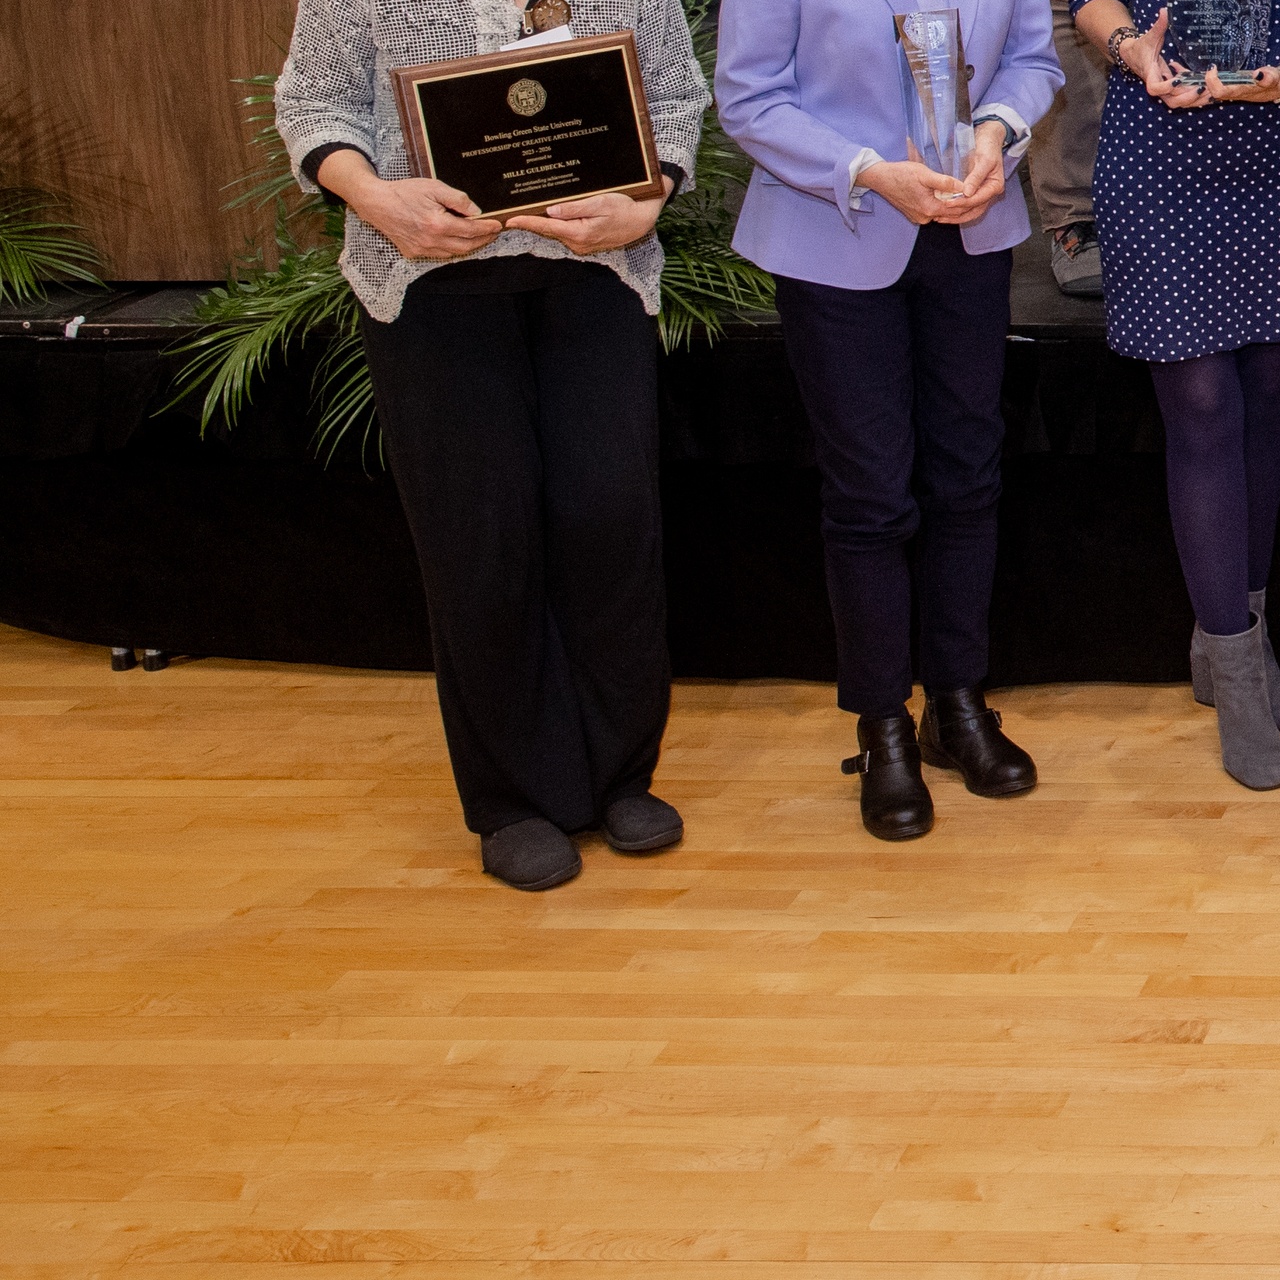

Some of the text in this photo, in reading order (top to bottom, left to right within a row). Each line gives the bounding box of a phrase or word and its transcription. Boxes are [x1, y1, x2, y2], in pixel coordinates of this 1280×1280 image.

[462, 144, 512, 158] PROFESSORSHIP
[521, 136, 552, 146] CREATIVE
[569, 125, 608, 137] EXCELLENCE
[484, 132, 512, 142] Bowling
[550, 119, 582, 129] University
